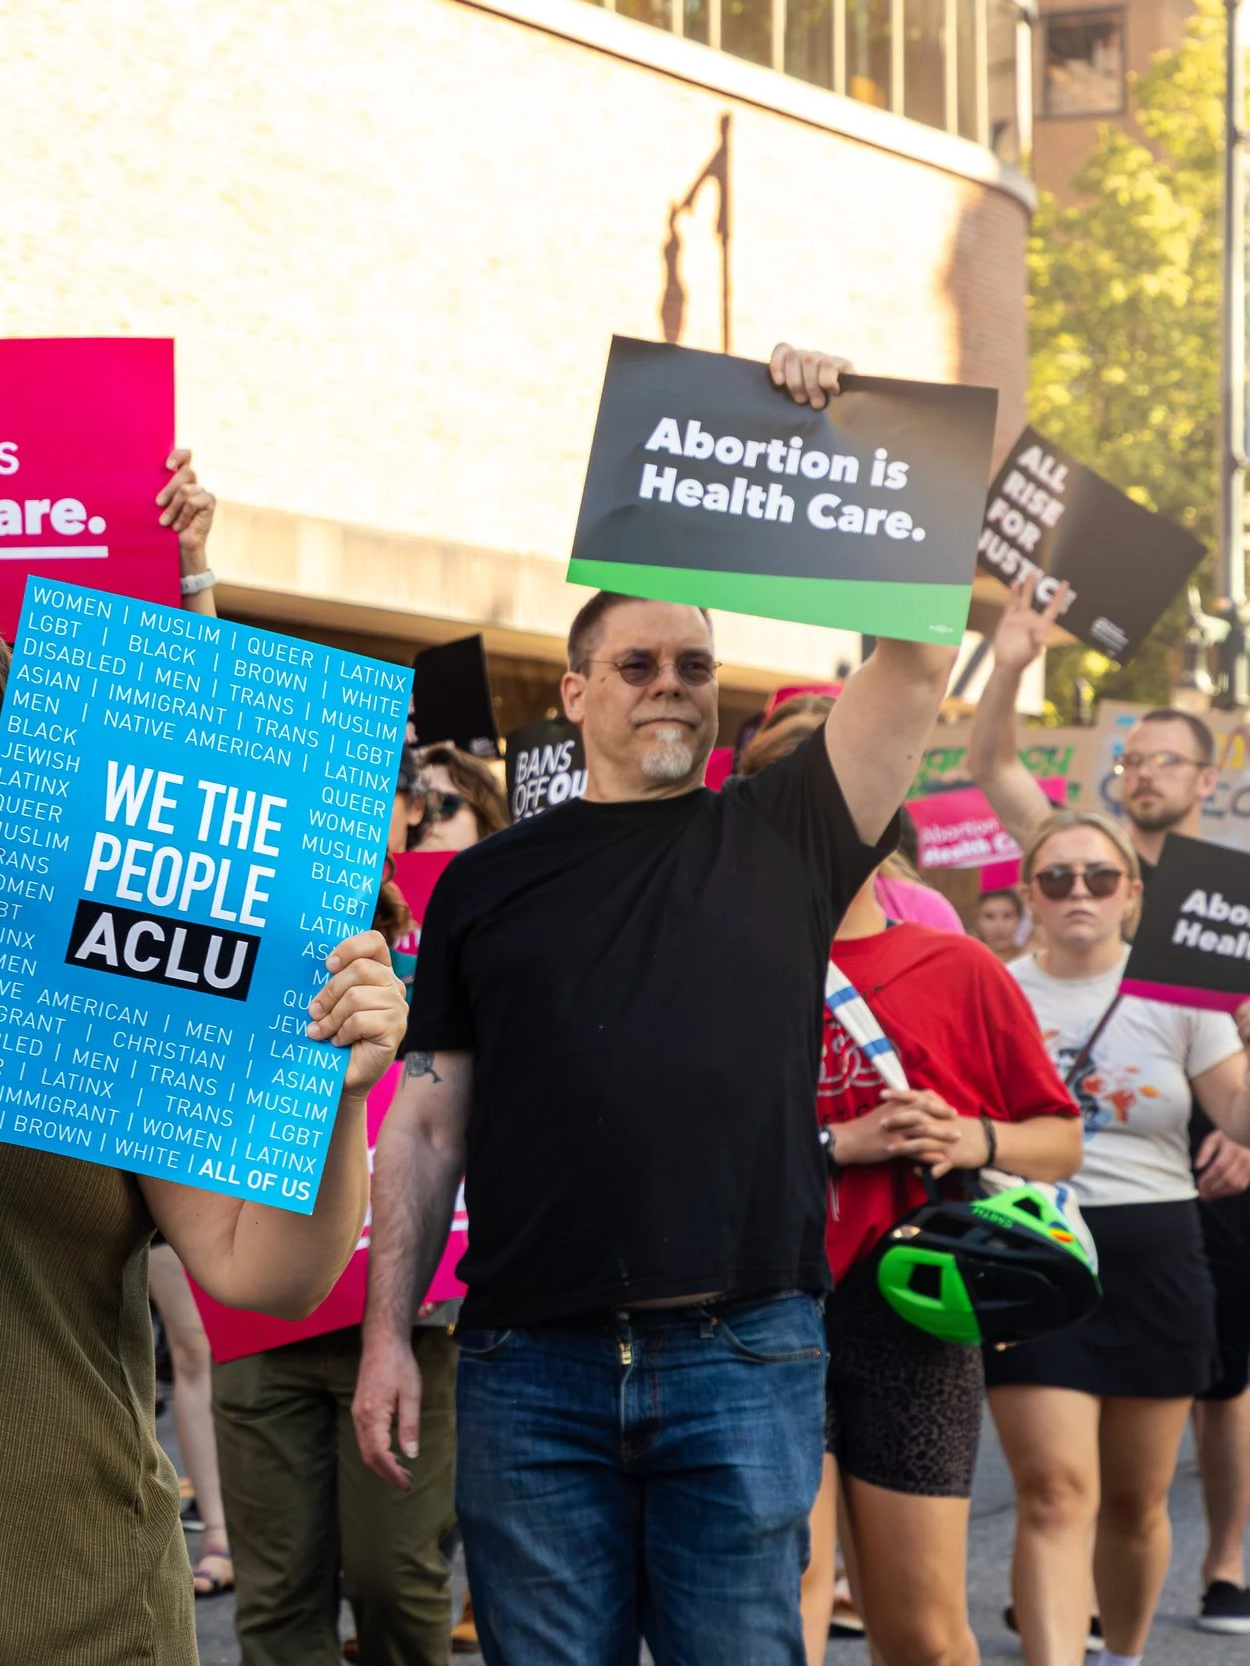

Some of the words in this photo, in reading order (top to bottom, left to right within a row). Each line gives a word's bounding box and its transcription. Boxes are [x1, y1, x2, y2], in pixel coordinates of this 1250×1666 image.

[645, 417, 860, 484] Abortion
[870, 448, 910, 490] is
[1017, 445, 1069, 493] ALL
[639, 463, 795, 523] Health
[807, 493, 926, 542] Care.
[987, 498, 1042, 552] FOR
[1002, 469, 1065, 528] RISE
[28, 612, 82, 638] LGBT
[128, 634, 196, 666] BLACK
[234, 659, 307, 693] BROWN
[342, 686, 401, 718] WHITE
[34, 586, 112, 619] WOMEN
[140, 611, 221, 645] MUSLIM
[247, 637, 314, 668] QUEER
[340, 660, 406, 693] LATINX
[16, 664, 80, 692] ASIAN
[109, 683, 227, 724] IMMIGRANT
[255, 716, 319, 748] TRANS
[345, 740, 395, 767] LGBT
[23, 637, 126, 675] DISABLED
[155, 667, 201, 693] MEN
[230, 684, 294, 715] TRANS
[321, 707, 397, 743] MUSLIM
[1, 742, 80, 773] JEWISH
[7, 715, 77, 746] BLACK
[13, 689, 60, 715] MEN
[104, 709, 175, 741] NATIVE
[184, 728, 291, 767] AMERICAN
[325, 761, 391, 793] LATINX
[515, 740, 575, 784] BANS
[105, 759, 184, 835] WE
[197, 779, 288, 857] THE
[309, 808, 382, 843] WOMEN
[321, 786, 386, 818] QUEER
[512, 775, 550, 818] OFF
[548, 768, 589, 806] OU
[83, 831, 276, 928] PEOPLE
[302, 833, 378, 868] MUSLIM
[311, 861, 374, 894] BLACK
[321, 891, 369, 918] LGBT
[74, 911, 249, 989] ACLU
[1172, 919, 1250, 960] Heal
[37, 989, 148, 1027] AMERICAN
[185, 1021, 233, 1046] MEN
[270, 1040, 341, 1071] LATINX
[269, 1014, 309, 1038] JEW
[73, 1048, 119, 1073] MEN
[151, 1065, 217, 1096] TRANS
[246, 1088, 328, 1123] MUSLIM
[113, 1031, 225, 1071] CHRISTIAN
[271, 1068, 334, 1097] ASIAN
[0, 1087, 120, 1125] IMMIGRANT
[143, 1117, 222, 1152] WOMEN
[245, 1143, 317, 1175] LATINX
[41, 1068, 114, 1098] LATINX
[166, 1095, 233, 1127] TRANS
[269, 1121, 323, 1148] LGBT
[14, 1115, 92, 1147] BROWN
[115, 1137, 181, 1169] WHITE
[198, 1158, 241, 1185] ALL
[247, 1169, 278, 1192] OF
[281, 1177, 311, 1201] US
